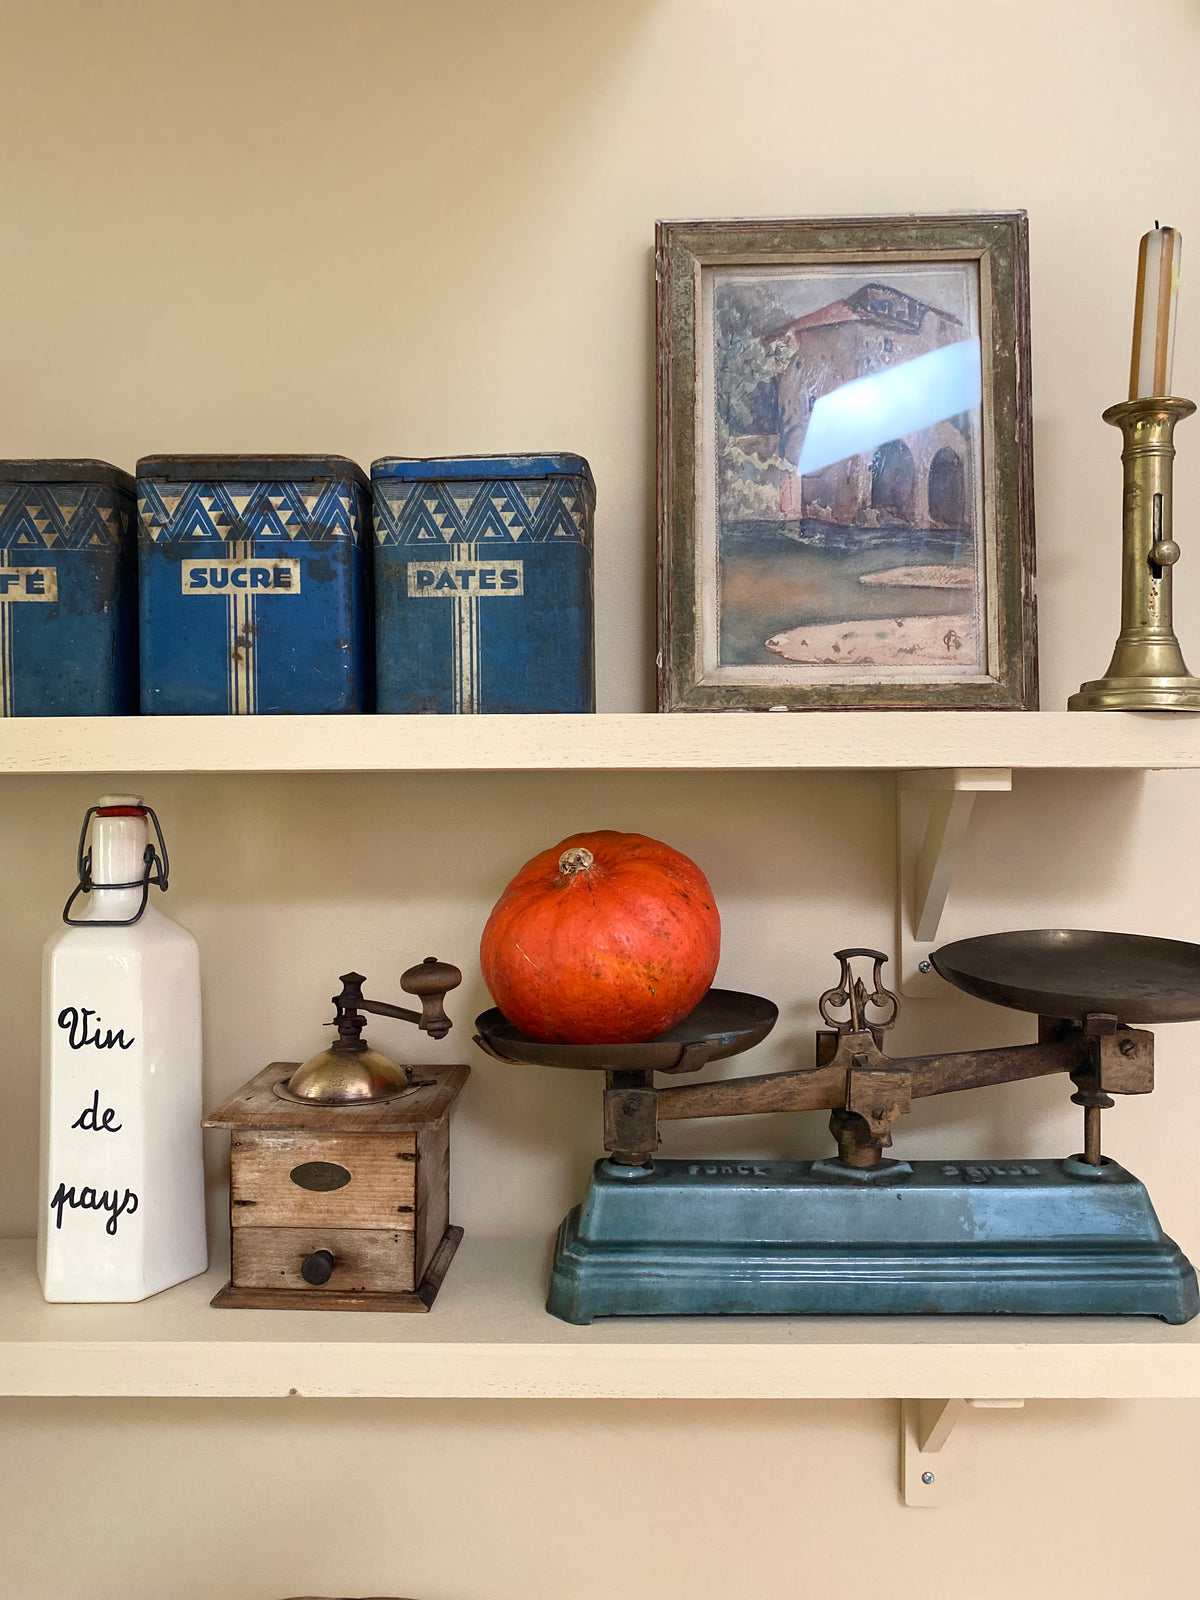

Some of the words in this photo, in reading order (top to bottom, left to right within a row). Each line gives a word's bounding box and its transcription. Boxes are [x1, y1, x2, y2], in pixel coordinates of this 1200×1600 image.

[189, 567, 292, 588] SUCRE
[416, 566, 519, 590] PÂTES
[58, 1007, 135, 1050] Vin
[71, 1089, 123, 1132] de
[51, 1182, 138, 1236] pays
